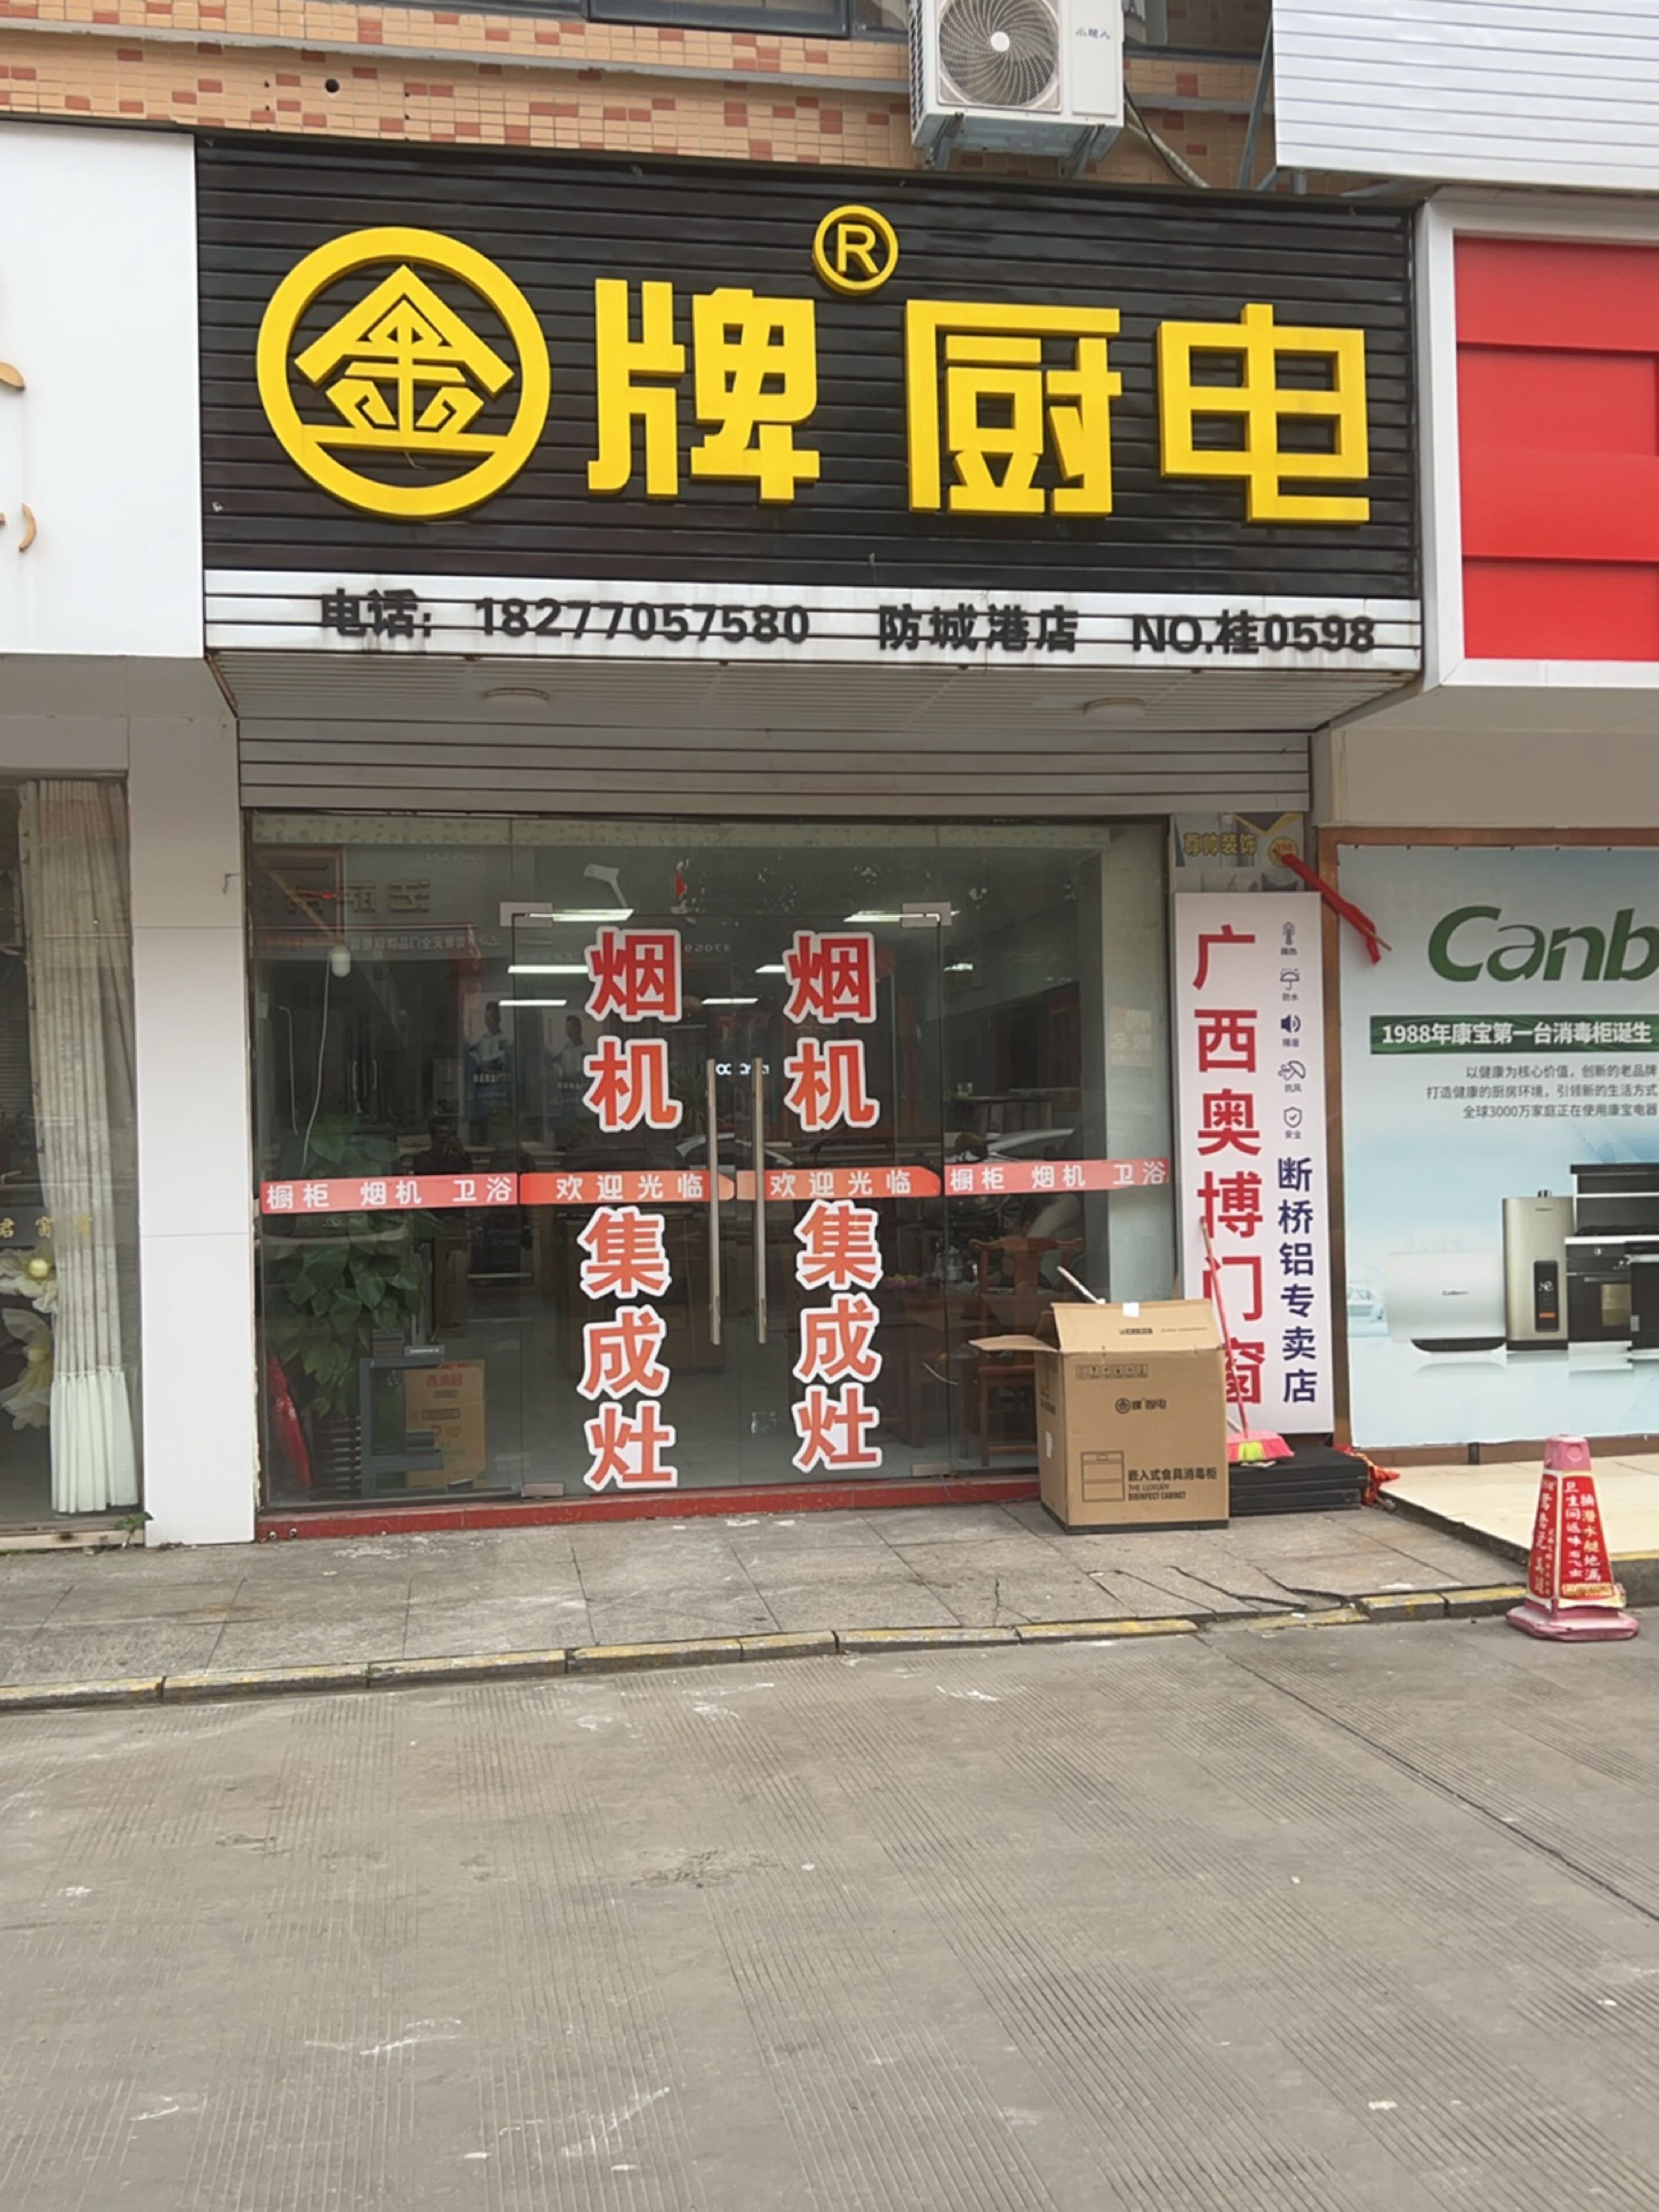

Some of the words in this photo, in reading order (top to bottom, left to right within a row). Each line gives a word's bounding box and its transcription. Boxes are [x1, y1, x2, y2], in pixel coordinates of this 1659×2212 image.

[474, 597, 810, 644] 18277057580
[878, 602, 1079, 653] 防城港店
[1131, 608, 1375, 657] NO.桂0598
[583, 926, 683, 1134] 烟机
[783, 930, 881, 1132] 烟机
[1381, 1022, 1653, 1045] 1988年康宝第一台消毒柜诞生
[266, 1183, 330, 1210] 橱柜
[360, 1180, 422, 1206] 烟机
[451, 1176, 512, 1203] 卫浴
[556, 1174, 704, 1200] 欢迎光临
[769, 1170, 911, 1197] 欢迎光临
[949, 1167, 1006, 1192] 橱柜
[1031, 1164, 1086, 1189] 烟机
[1112, 1160, 1167, 1186] 卫浴
[1277, 1157, 1318, 1404] 断桥铝专卖店
[577, 1206, 678, 1491] 集成灶
[791, 1199, 883, 1473] 集成灶
